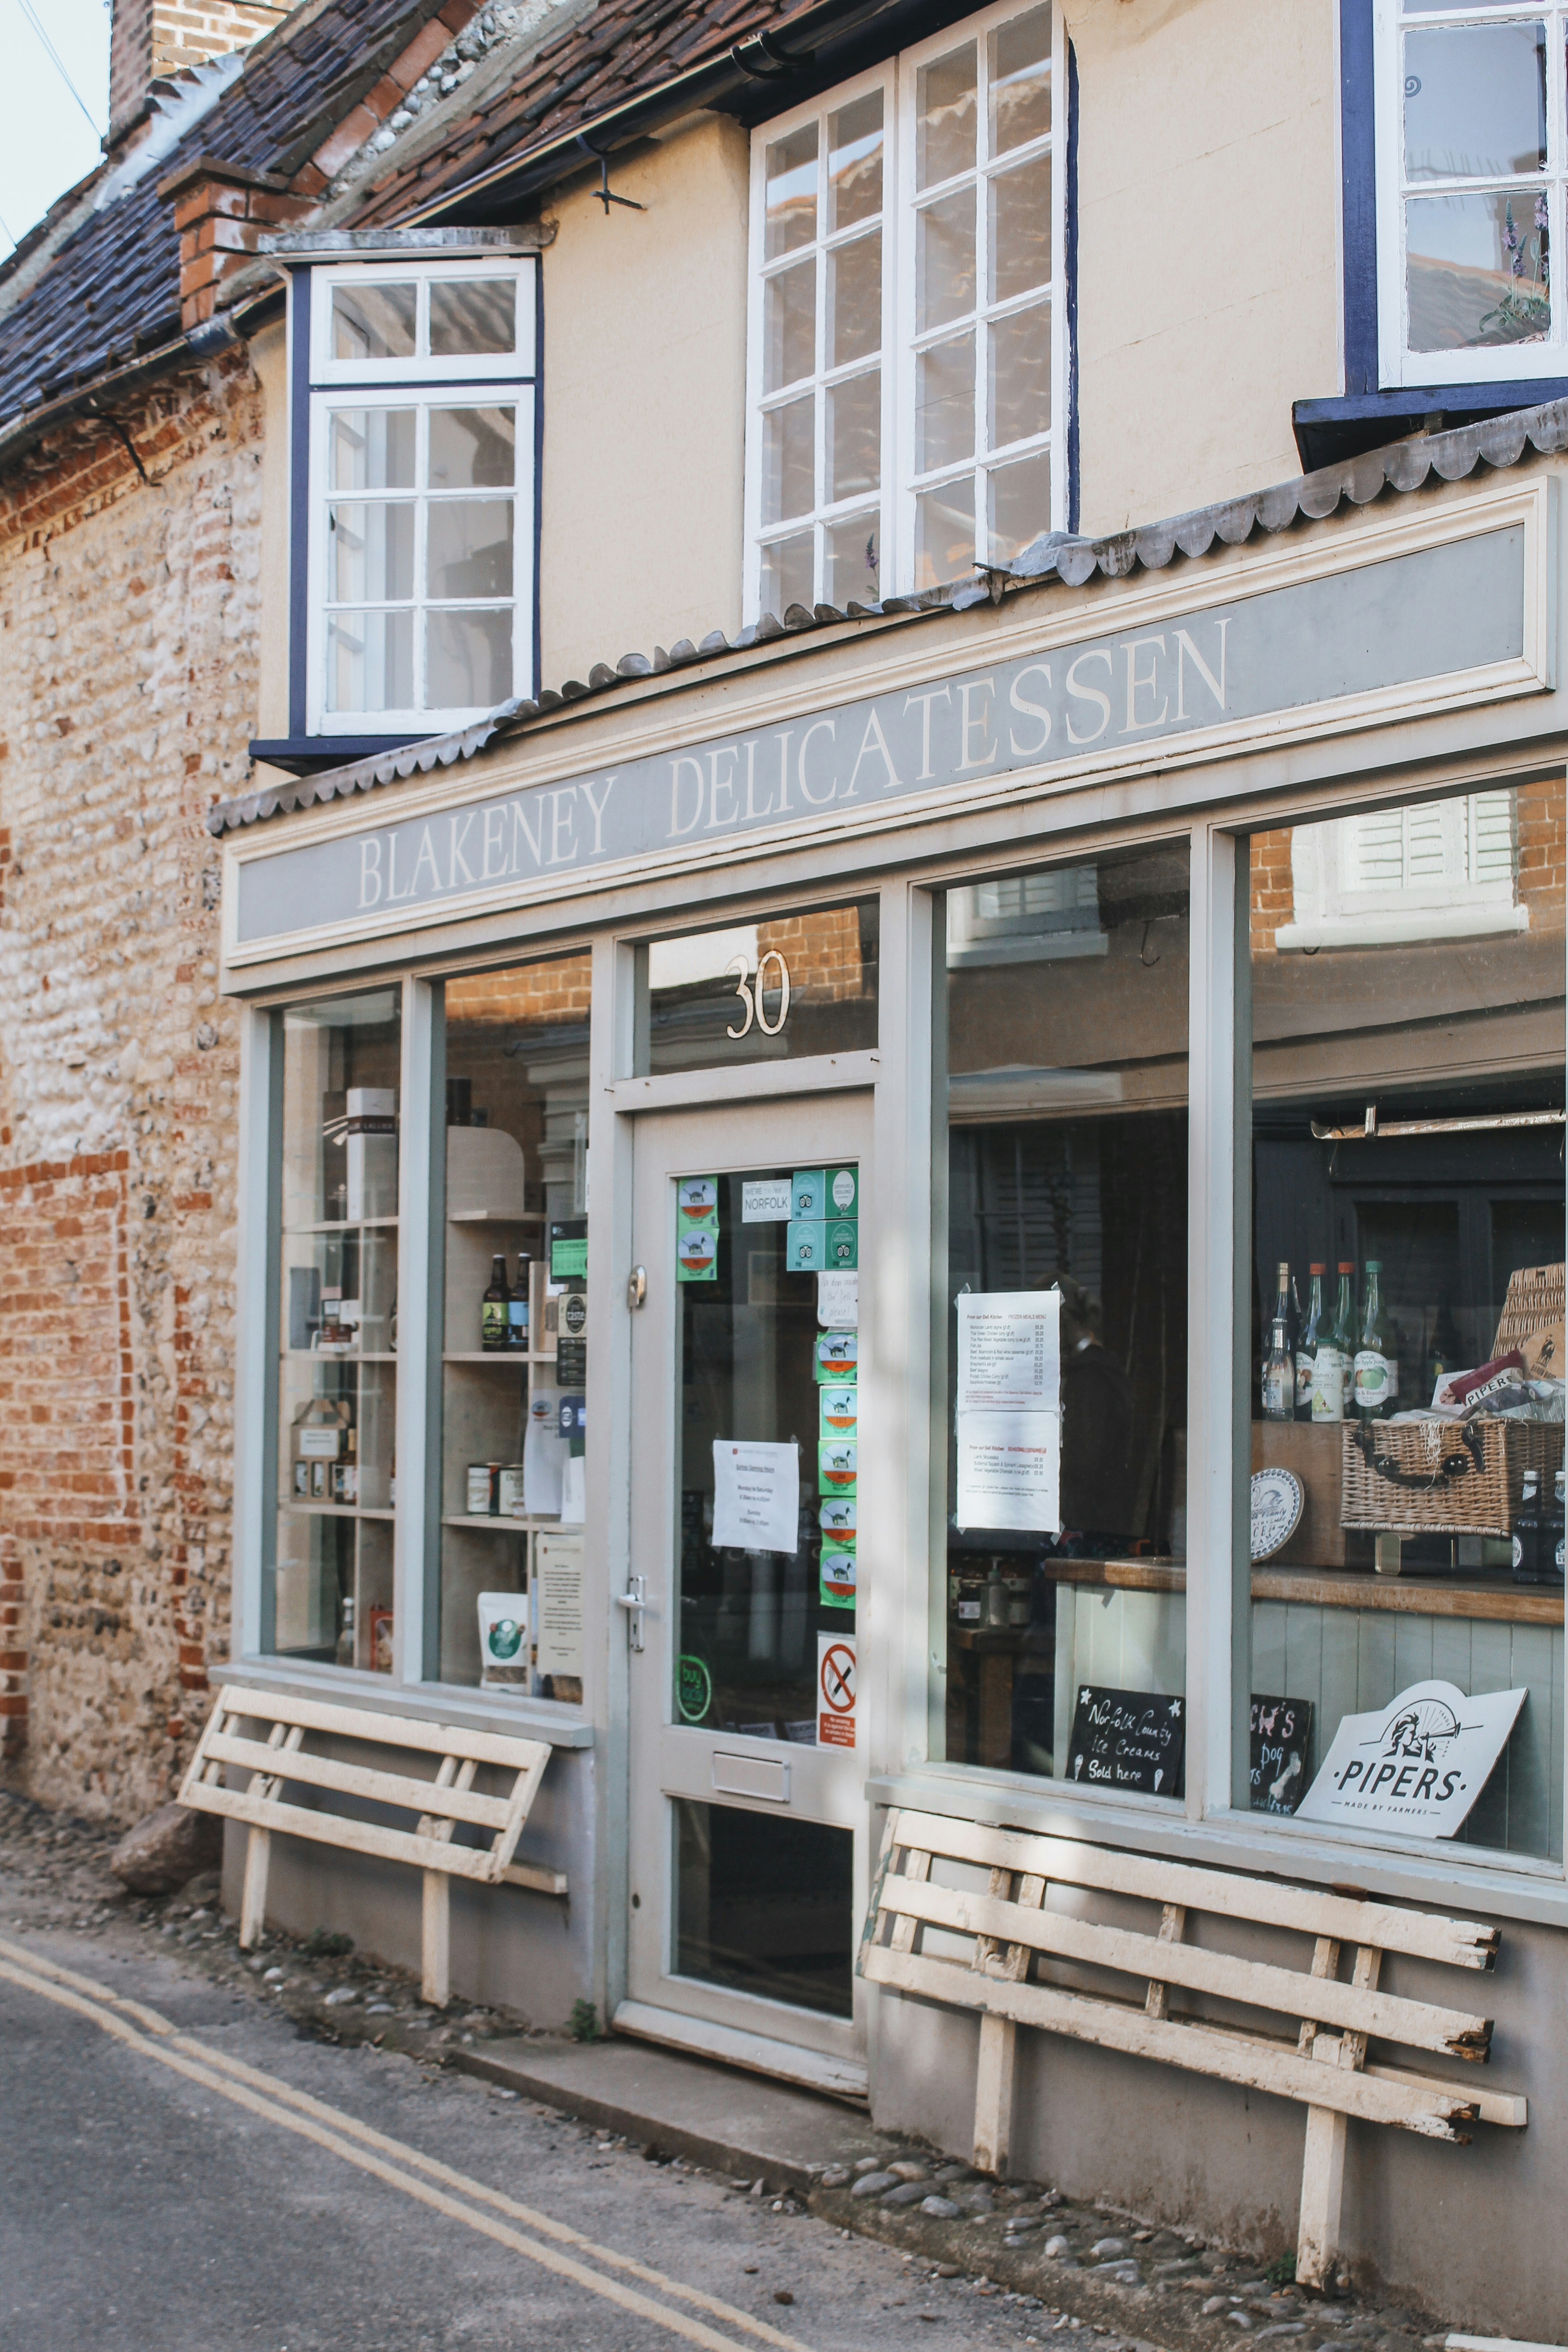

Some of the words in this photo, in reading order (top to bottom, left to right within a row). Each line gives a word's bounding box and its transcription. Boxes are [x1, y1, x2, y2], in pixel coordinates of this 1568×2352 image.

[358, 775, 619, 908] BLAKENEY
[669, 617, 1232, 837] DELICATESSEN
[726, 950, 789, 1038] 30
[745, 1196, 788, 1210] NORFOLK
[1088, 1700, 1136, 1735] Norfolk
[1135, 1710, 1171, 1747] County
[1092, 1735, 1108, 1754] Ice
[1116, 1739, 1161, 1760] Creams
[1088, 1759, 1112, 1779] Sold
[1117, 1764, 1142, 1784] here
[1338, 1761, 1462, 1801] PIPERS
[1344, 1801, 1368, 1810] MADE
[1387, 1806, 1427, 1815] FARMERS
